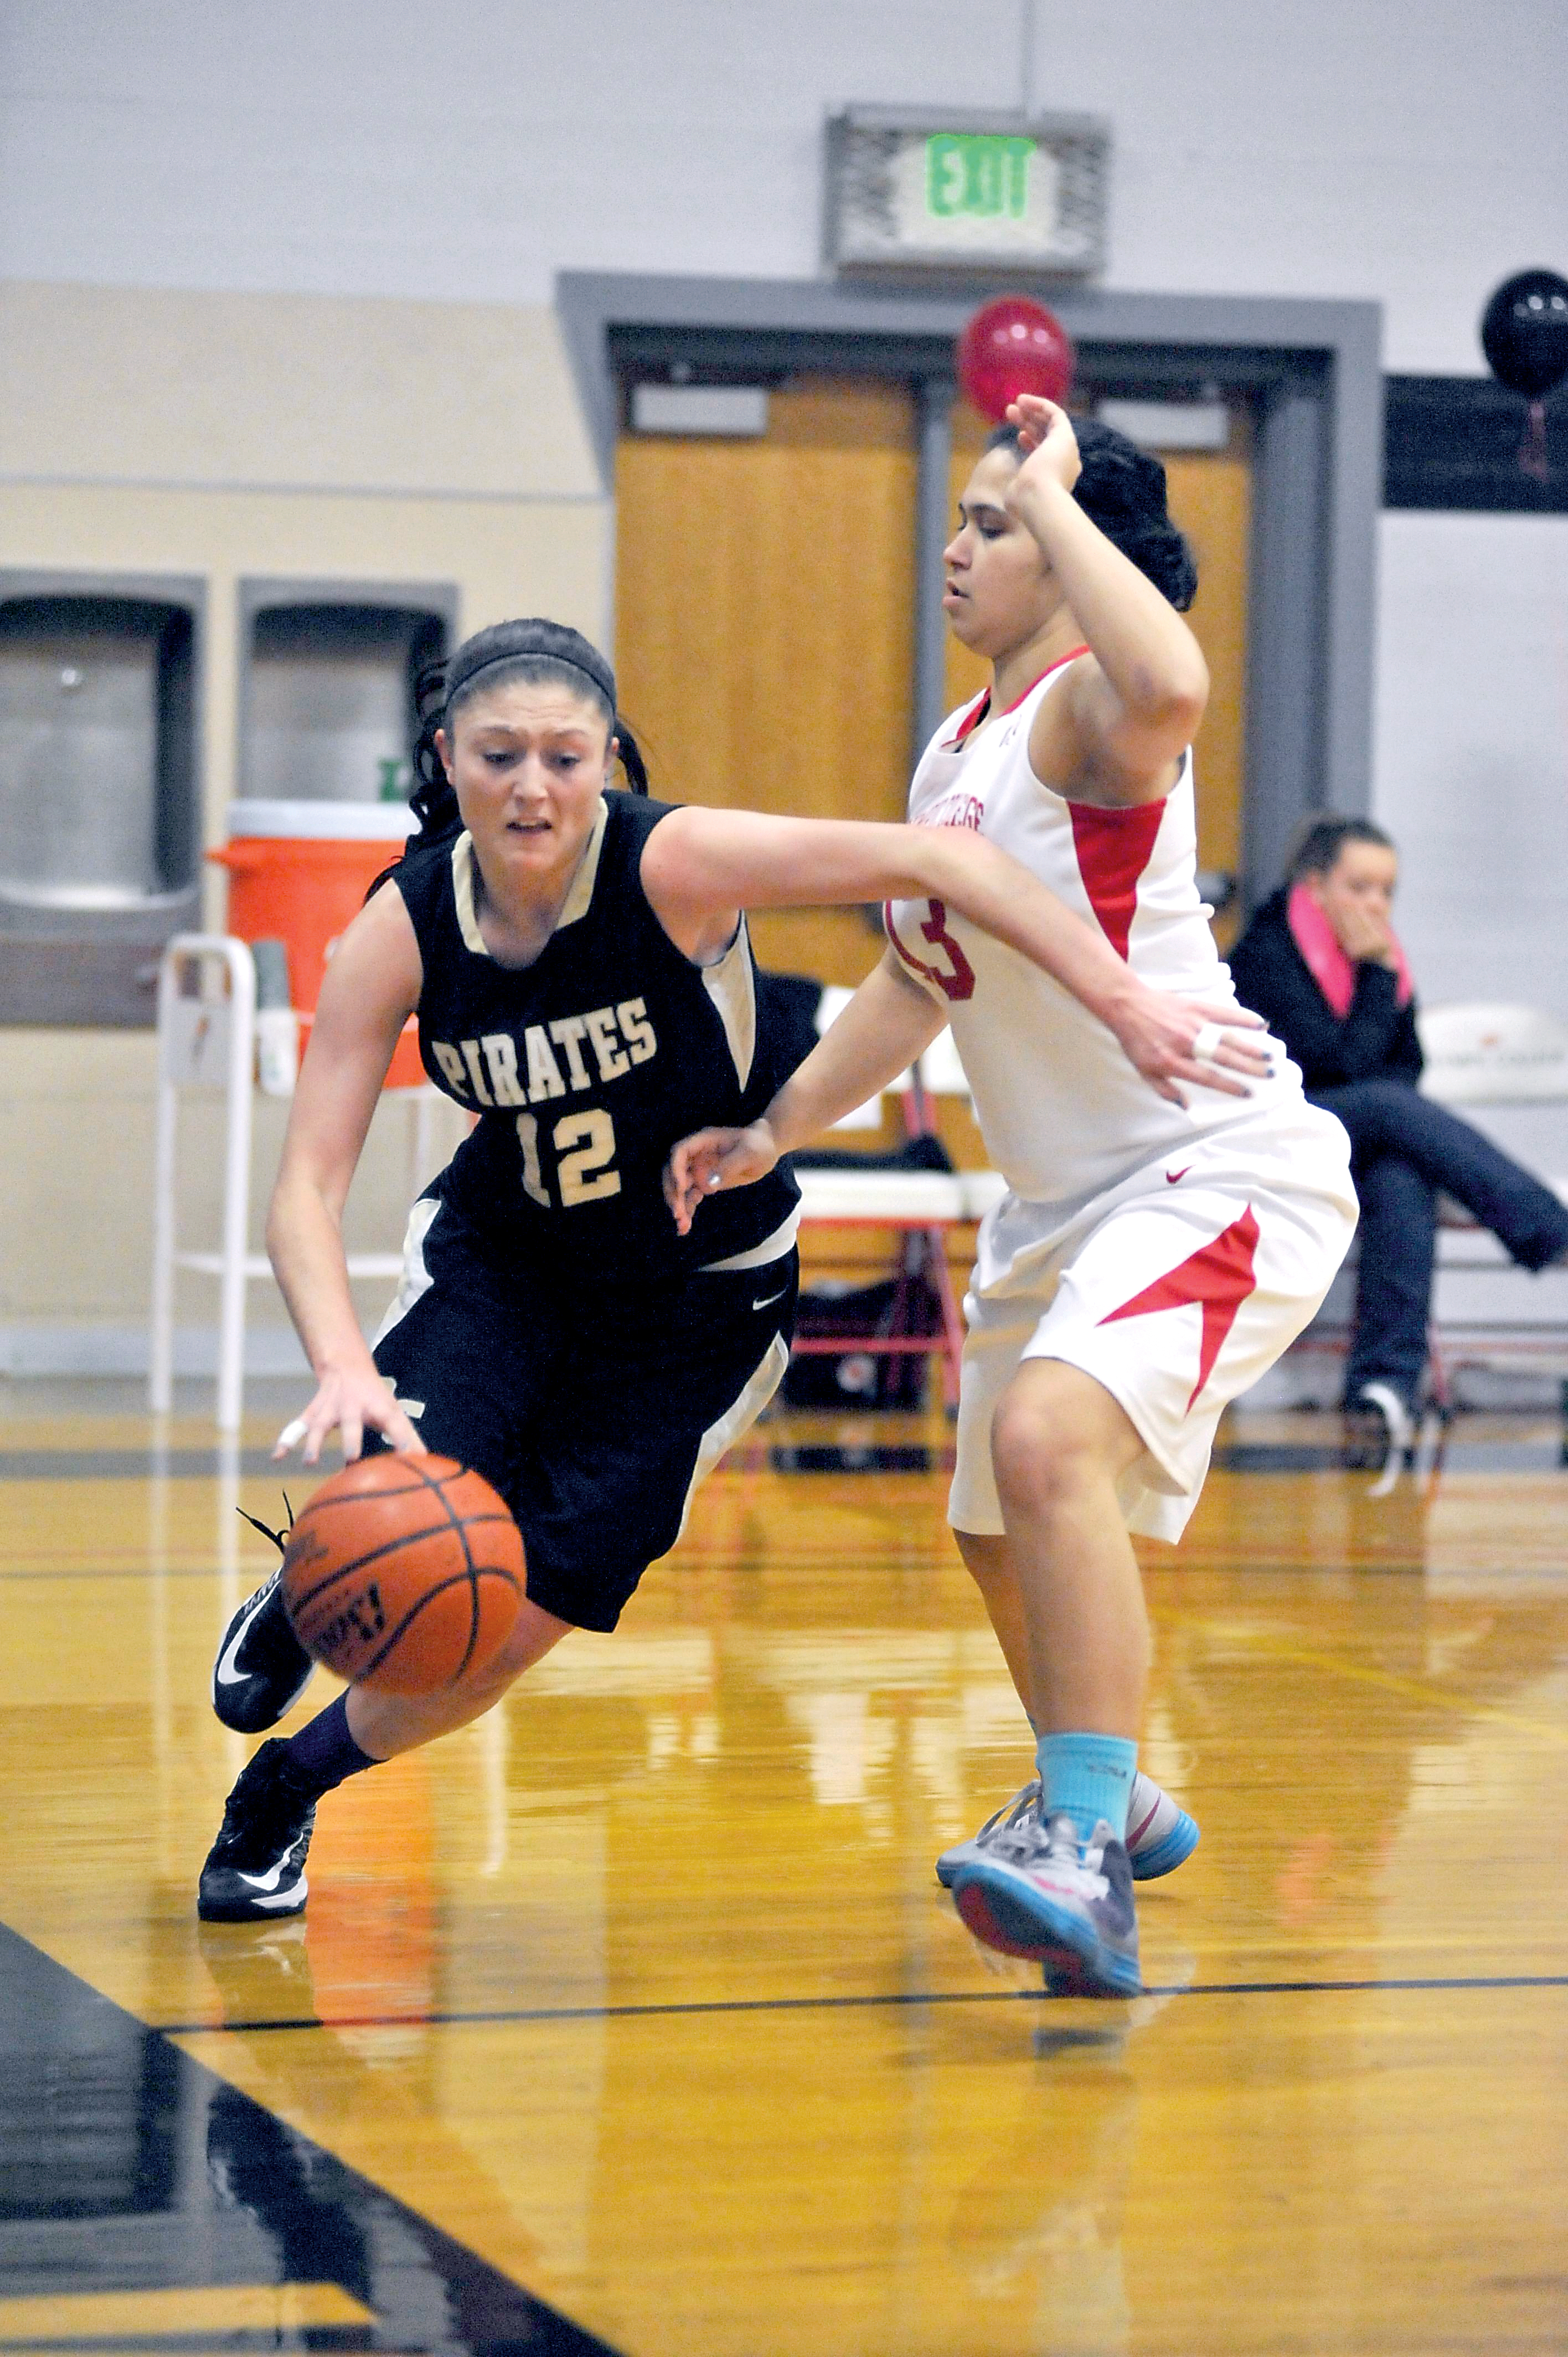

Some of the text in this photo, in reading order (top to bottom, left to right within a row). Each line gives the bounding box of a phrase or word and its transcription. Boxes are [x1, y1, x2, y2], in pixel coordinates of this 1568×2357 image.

[925, 133, 1036, 218] EXIT
[431, 997, 658, 1107] PIRATES
[516, 1108, 622, 1208] 12
